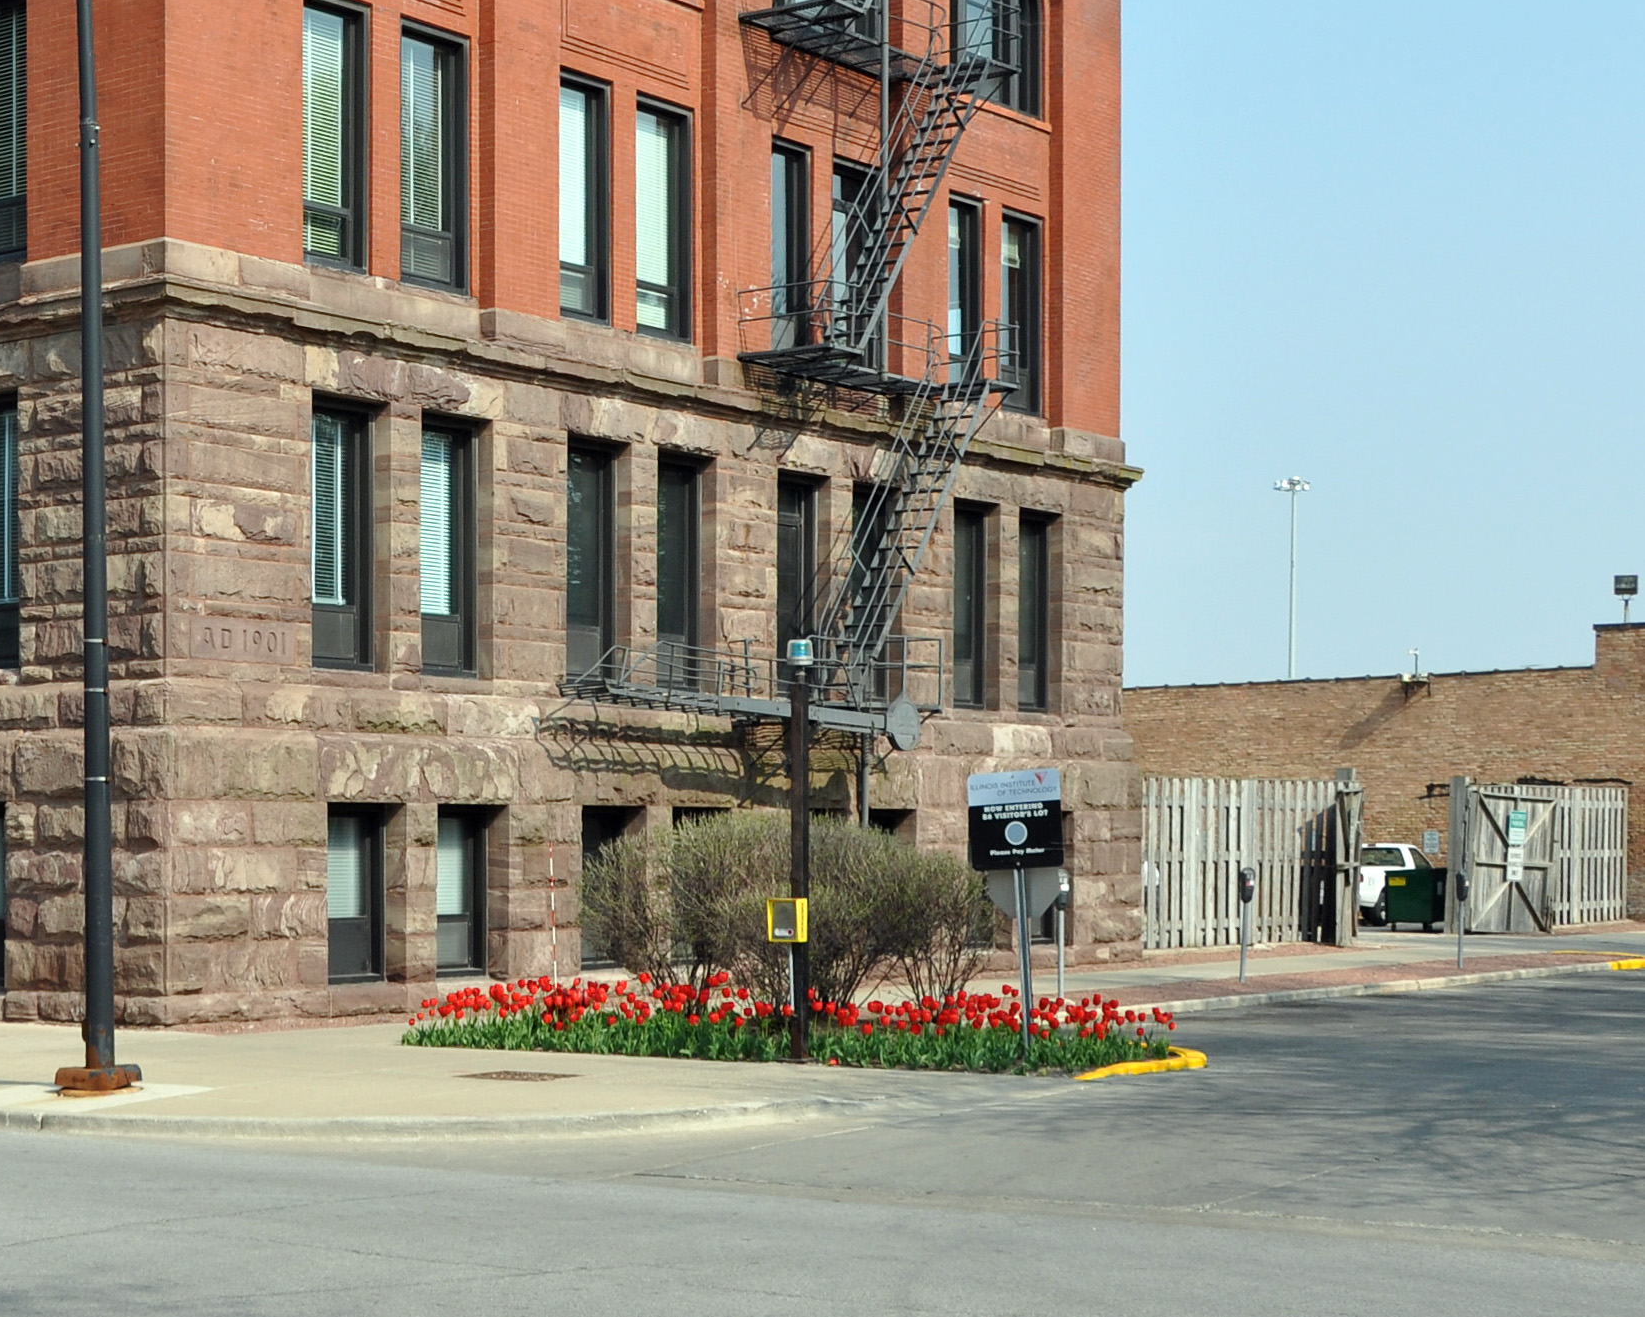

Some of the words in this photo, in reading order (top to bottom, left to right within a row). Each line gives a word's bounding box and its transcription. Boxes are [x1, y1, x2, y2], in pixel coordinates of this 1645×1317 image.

[243, 629, 286, 654] 1901
[970, 782, 998, 791] ILLINOIS
[1000, 779, 1035, 788] INSTITUTE
[997, 789, 1006, 797] OF
[1009, 786, 1057, 795] TECHNOLOGY
[983, 805, 1003, 813] NOW
[1004, 802, 1044, 811] ENTERING
[1033, 808, 1049, 817] LOT
